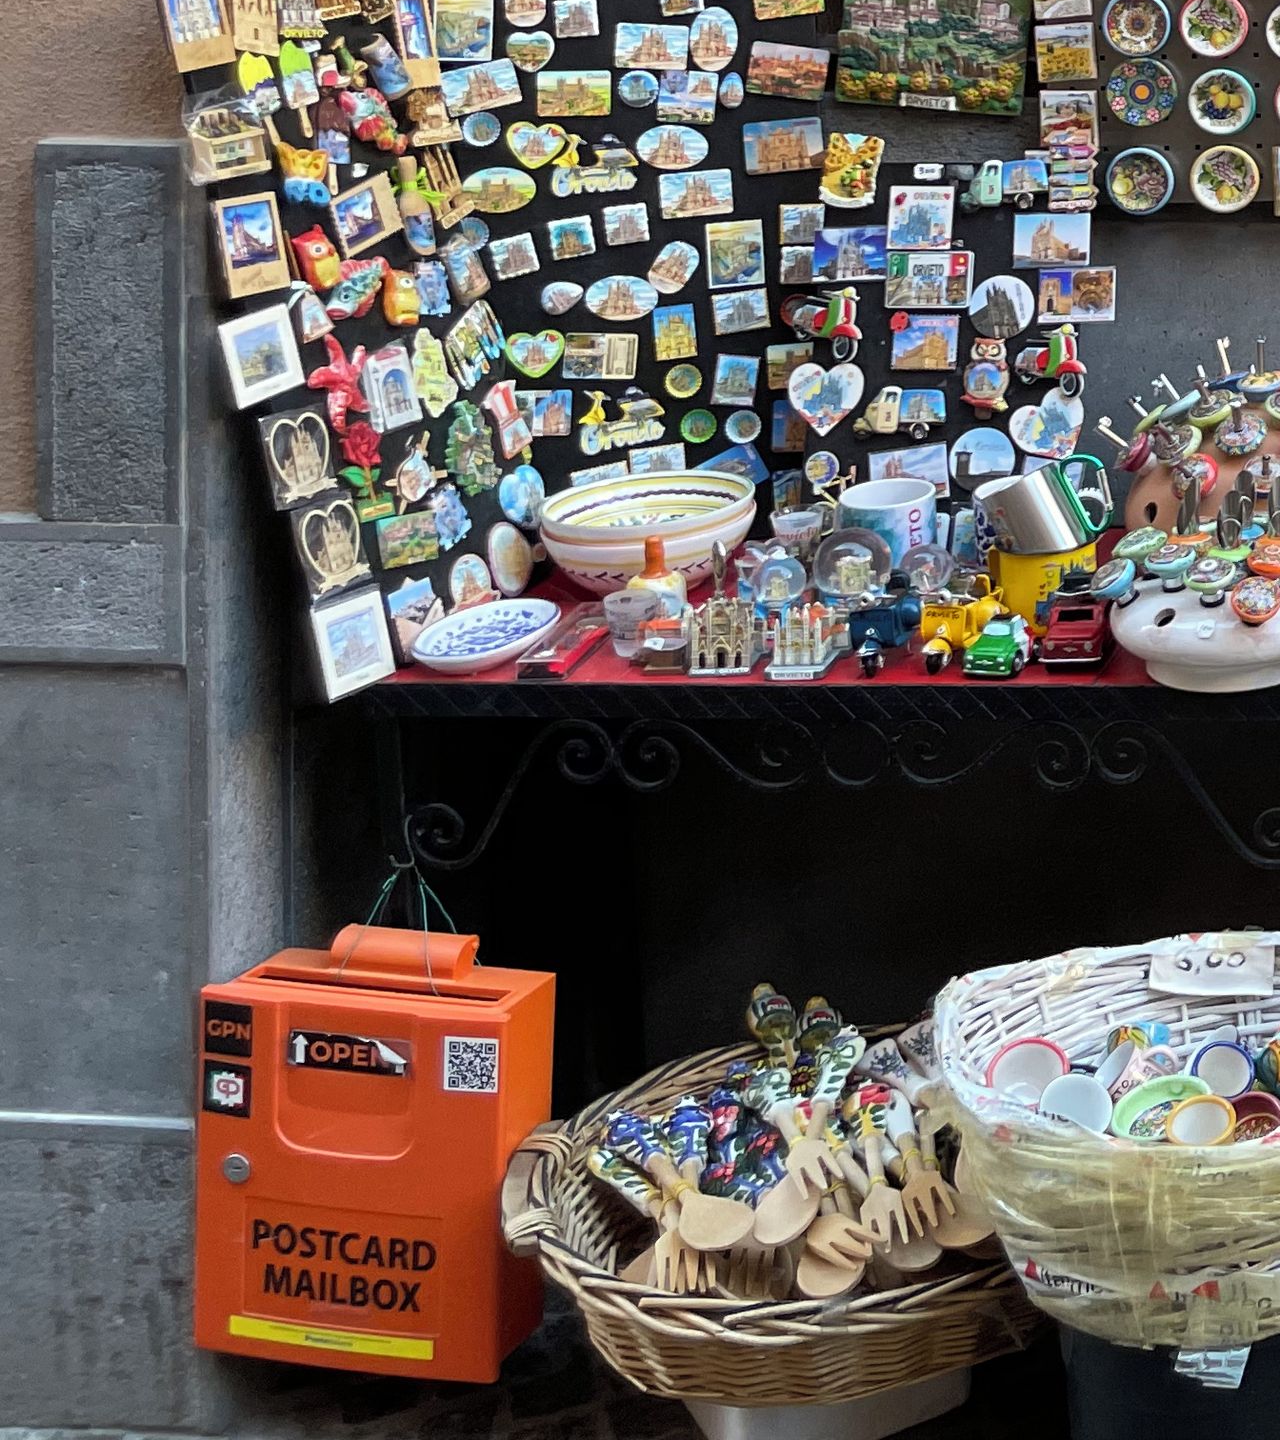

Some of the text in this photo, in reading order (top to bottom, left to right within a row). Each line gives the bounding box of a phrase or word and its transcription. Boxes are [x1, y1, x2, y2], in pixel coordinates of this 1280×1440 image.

[913, 263, 944, 278] ORVIETO
[772, 671, 812, 680] ORVIETO
[207, 1018, 251, 1041] GPN
[252, 1218, 438, 1272] POSTCARD
[263, 1263, 422, 1313] MAILBOX
